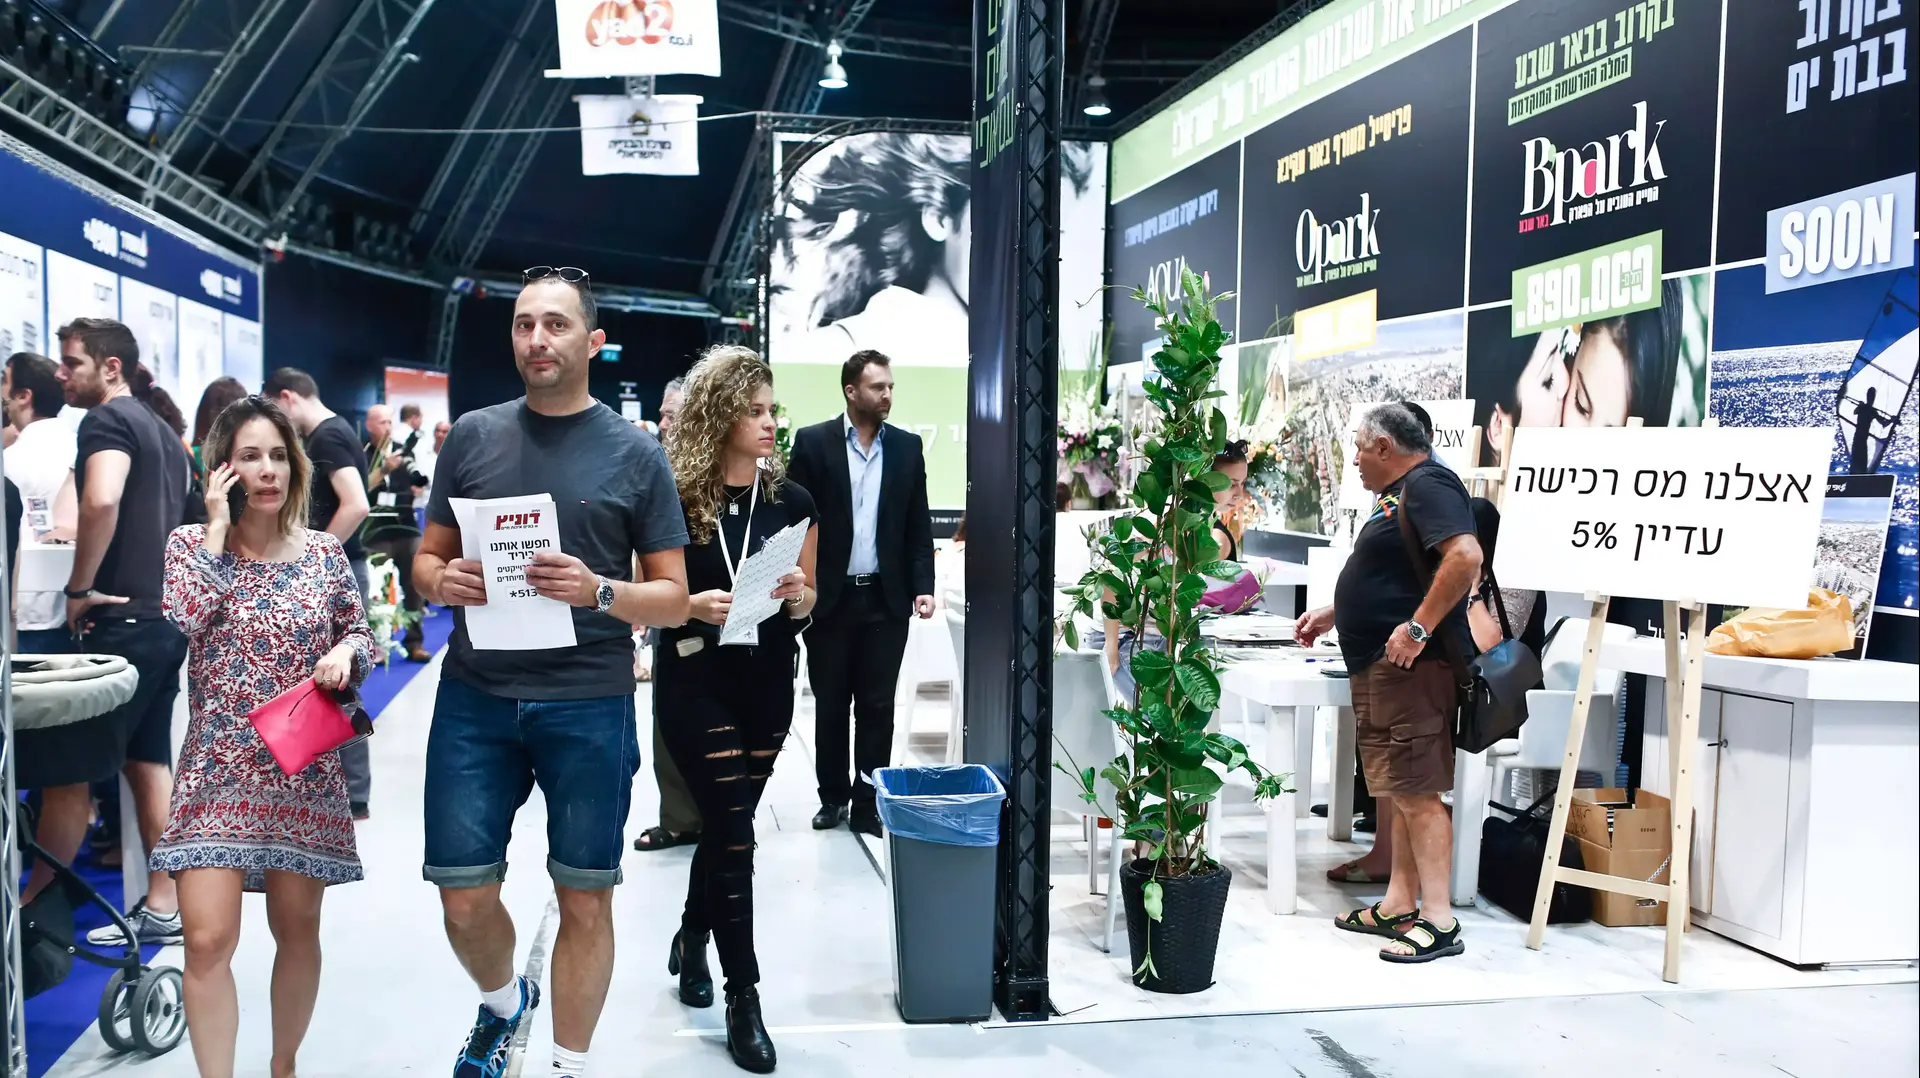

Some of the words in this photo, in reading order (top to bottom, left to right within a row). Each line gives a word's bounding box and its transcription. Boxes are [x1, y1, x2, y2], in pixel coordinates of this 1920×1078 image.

[1614, 0, 1675, 50] בקרוב
[1561, 18, 1607, 70] בבאר
[1515, 42, 1555, 90] שבע
[1600, 53, 1629, 83] החלה
[1831, 28, 1907, 101] בבת
[1554, 66, 1598, 102] ההרשמה
[1786, 56, 1821, 114] ים
[1511, 85, 1552, 120] המוקדמת
[1295, 192, 1381, 284] Opark
[1778, 192, 1894, 279] SOON
[1434, 423, 1465, 448] אצל
[1514, 464, 1619, 497] רכישה
[1633, 469, 1688, 498] מס
[1704, 463, 1813, 503] אצלנו
[495, 512, 541, 531] דוניץ
[1571, 520, 1618, 550] 5%
[490, 541, 518, 552] אותנו
[521, 538, 551, 550] חפשו
[1634, 521, 1725, 562] עדיין
[496, 574, 525, 583] מיוחדים
